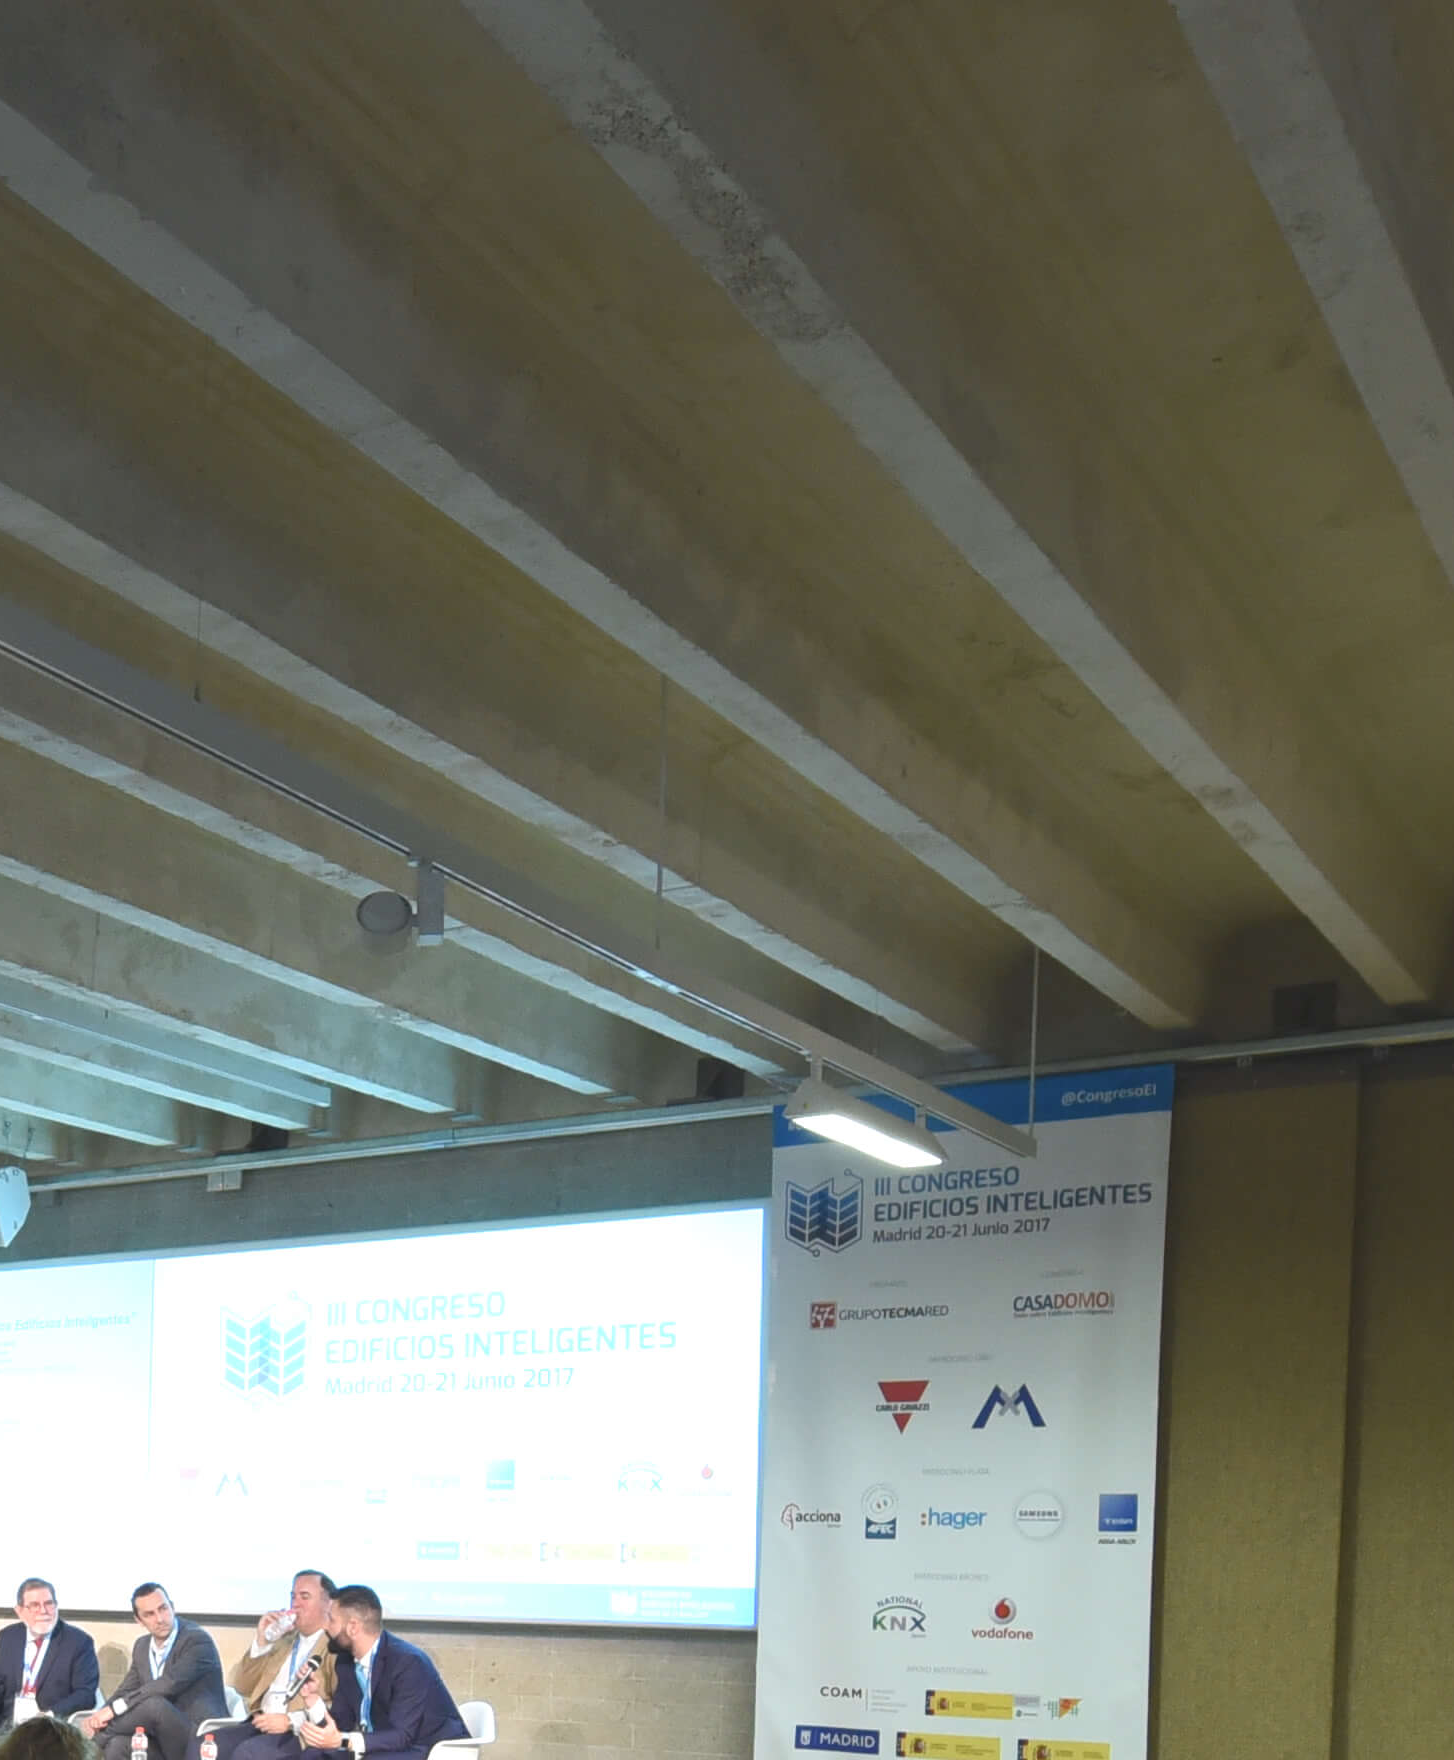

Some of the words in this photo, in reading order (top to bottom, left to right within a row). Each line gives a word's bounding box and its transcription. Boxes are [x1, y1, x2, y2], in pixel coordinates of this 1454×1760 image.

[1060, 1083, 1158, 1107] @CongresoEI
[874, 1176, 892, 1197] III
[897, 1166, 1021, 1194] CONGRESO
[873, 1198, 980, 1222] EDIFICIOS
[985, 1183, 1153, 1215] INTELIGENTES
[872, 1225, 923, 1244] Madrid
[926, 1224, 969, 1240] 20-21
[972, 1221, 1009, 1236] Junio
[1013, 1218, 1051, 1234] 2017
[327, 1299, 348, 1328] III
[355, 1291, 507, 1326] CONGRESO
[1012, 1292, 1110, 1312] CASADOMO
[838, 1304, 950, 1322] GRUPOTECMARED
[325, 1333, 455, 1365] EDIFICIOS
[463, 1321, 678, 1359] INTELIGENTES
[325, 1375, 393, 1396] Madrid
[400, 1372, 458, 1393] 20-21
[462, 1371, 517, 1392] Junio
[523, 1367, 576, 1389] 2017
[795, 1509, 842, 1524] acciona
[928, 1507, 987, 1530] hager
[876, 1595, 924, 1609] NATIONAL
[873, 1615, 927, 1633] KNX
[971, 1627, 1034, 1641] vodafone
[819, 1686, 863, 1699] COAM
[819, 1732, 876, 1749] MADRID
